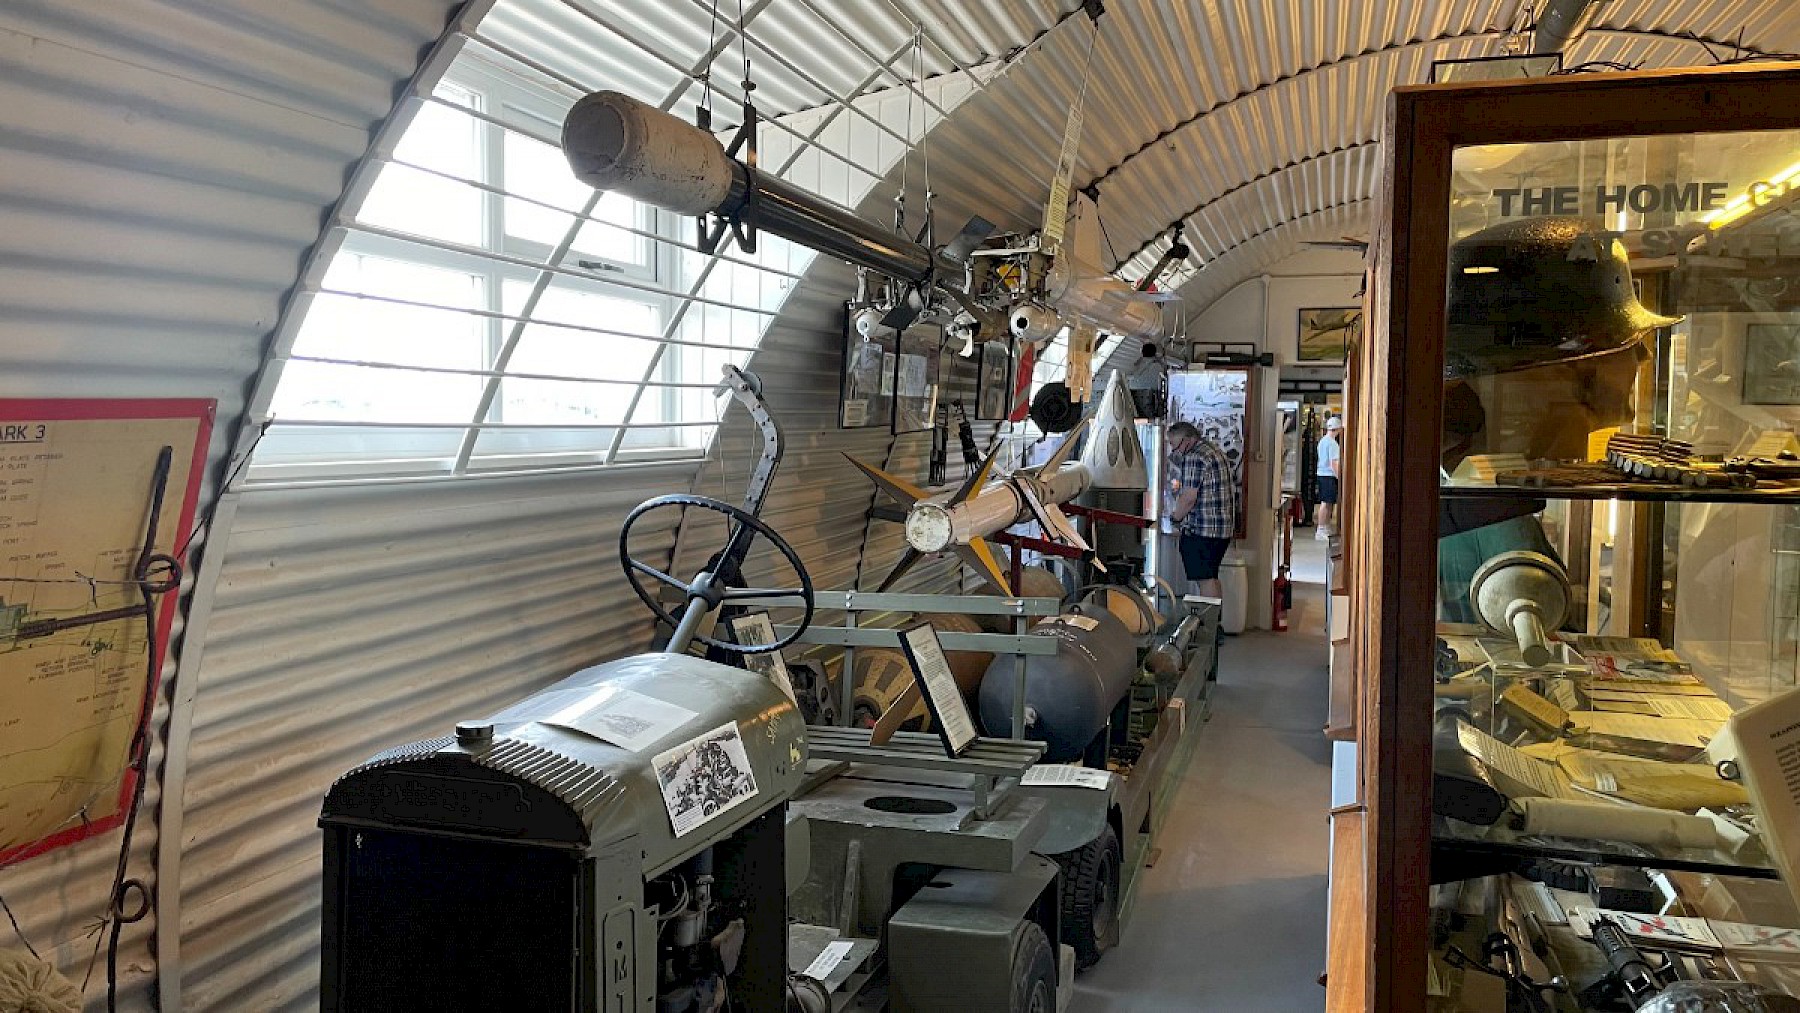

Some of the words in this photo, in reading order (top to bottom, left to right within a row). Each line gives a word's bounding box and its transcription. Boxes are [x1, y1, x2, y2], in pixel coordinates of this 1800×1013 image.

[1493, 186, 1580, 216] THE
[1596, 182, 1729, 214] HOME
[1565, 230, 1624, 262] AT
[35, 424, 46, 439] 3
